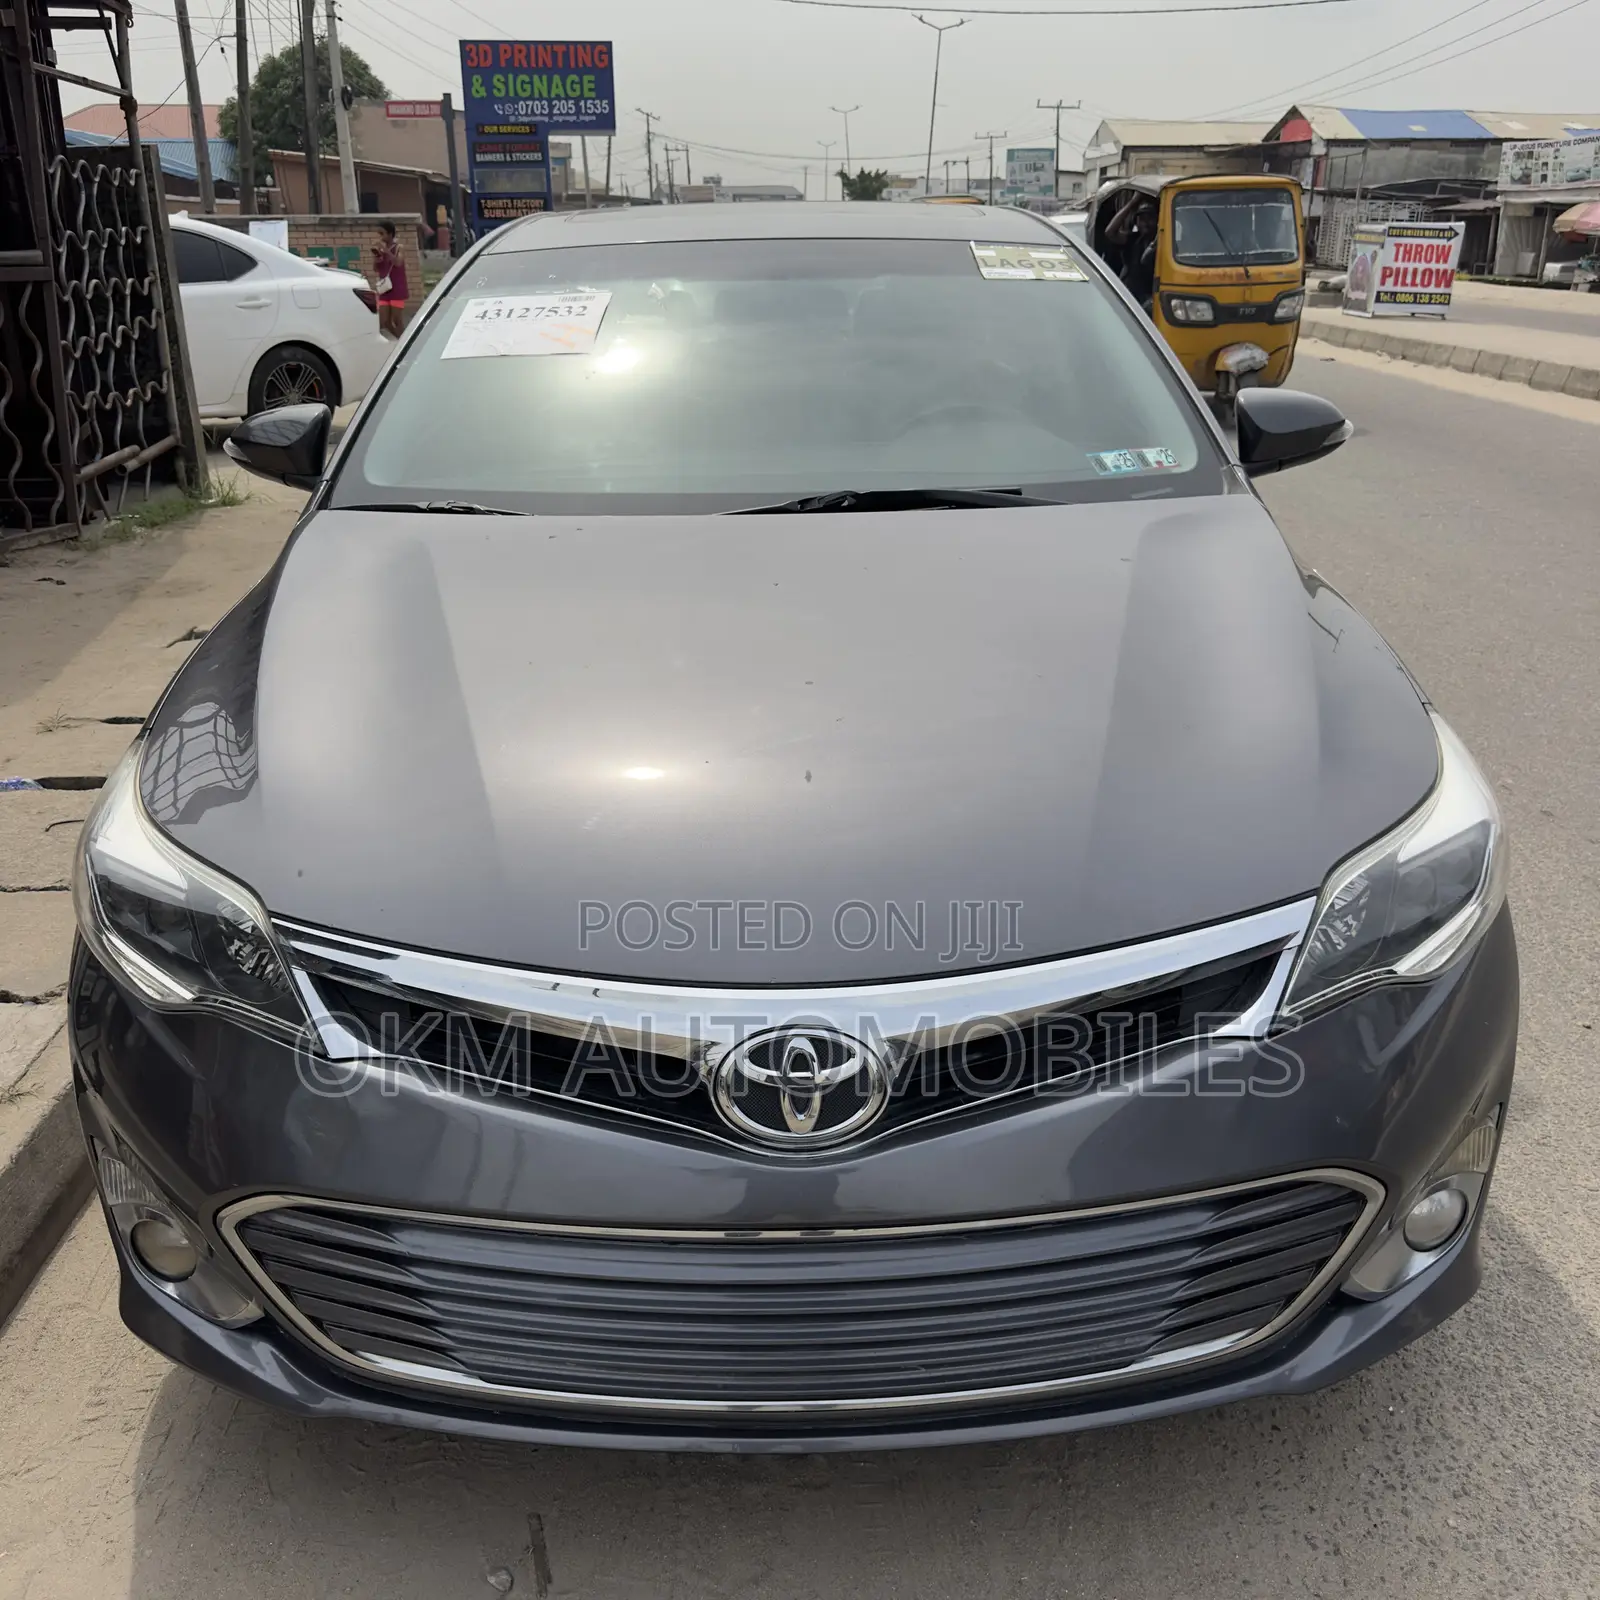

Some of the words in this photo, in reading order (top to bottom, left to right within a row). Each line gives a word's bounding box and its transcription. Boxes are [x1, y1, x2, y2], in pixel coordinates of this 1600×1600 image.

[466, 44, 492, 68] 3D
[499, 44, 609, 68] PRINTING
[471, 74, 487, 98] &
[492, 74, 596, 98] SIGNAGE
[552, 100, 576, 114] 205
[579, 100, 609, 114] 1535
[484, 125, 499, 133] OUR
[499, 125, 530, 133] SERVICES
[1537, 139, 1571, 149] FURNITURE
[475, 153, 505, 162] BANNERS
[512, 152, 542, 161] STICKERS
[513, 199, 545, 208] FACTORY
[1394, 243, 1452, 264] THROW
[979, 258, 1075, 270] LAGOS
[1380, 266, 1456, 288] PILLOW
[1396, 293, 1414, 303] 0806
[1430, 294, 1450, 304] 2542
[474, 305, 588, 320] 43127532
